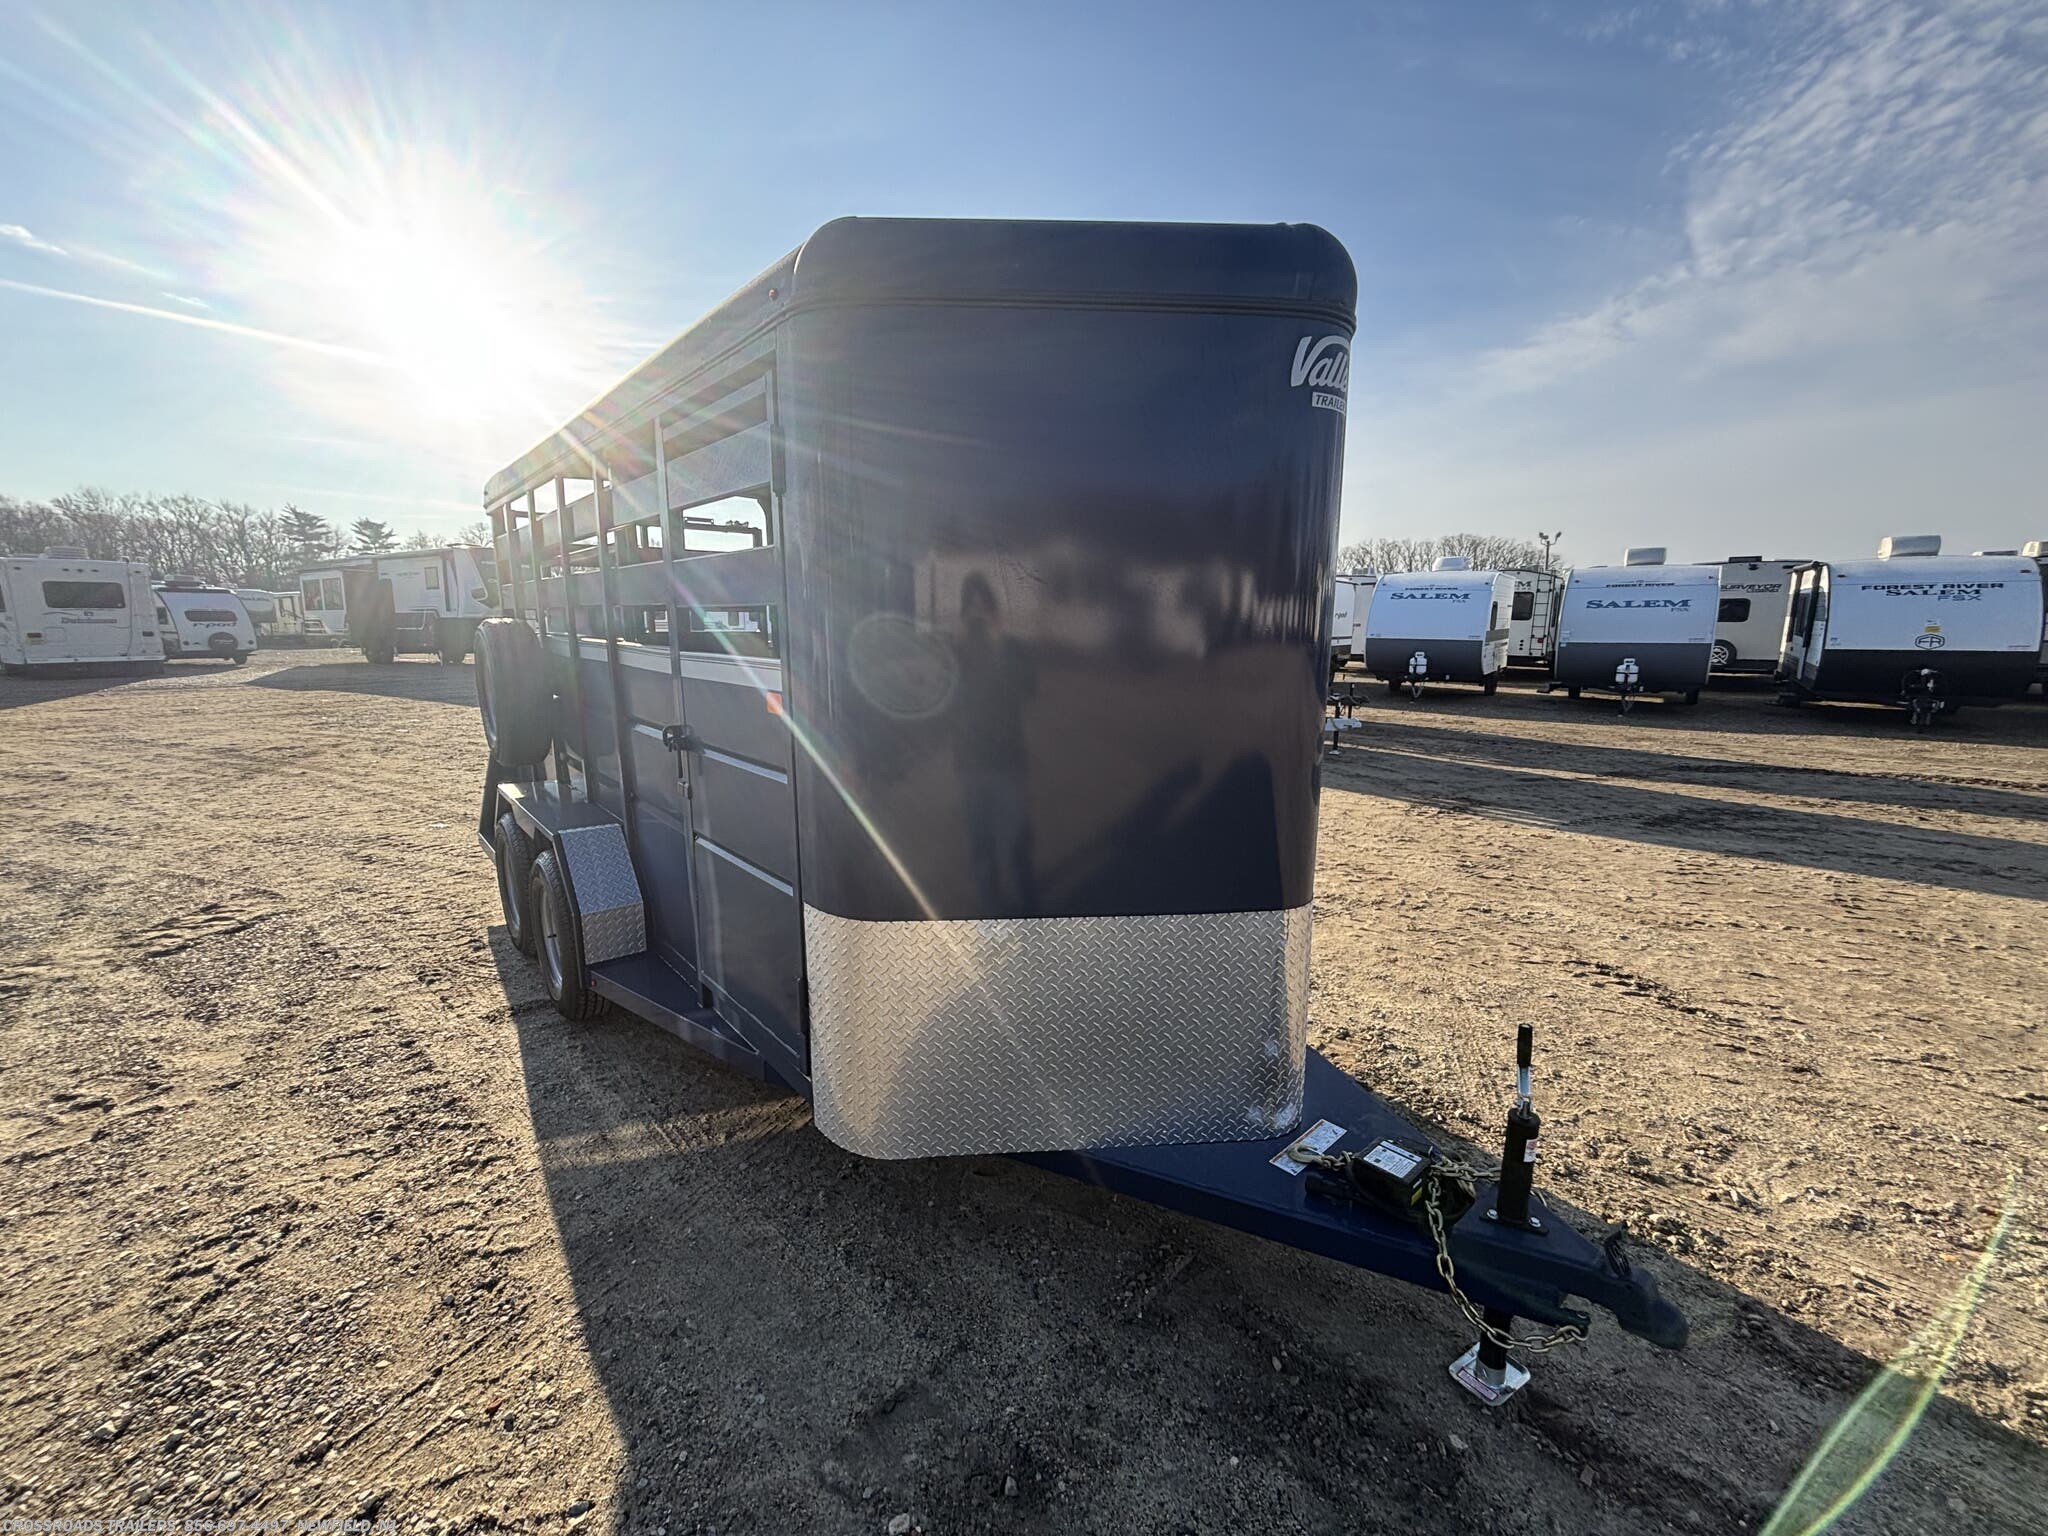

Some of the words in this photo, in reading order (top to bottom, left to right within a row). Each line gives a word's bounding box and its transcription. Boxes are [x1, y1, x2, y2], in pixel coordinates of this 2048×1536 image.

[1861, 583, 1938, 591] FOREST
[1390, 592, 1471, 600] SALEM
[1885, 589, 1982, 597] SALEM
[1585, 599, 1693, 609] SALEM
